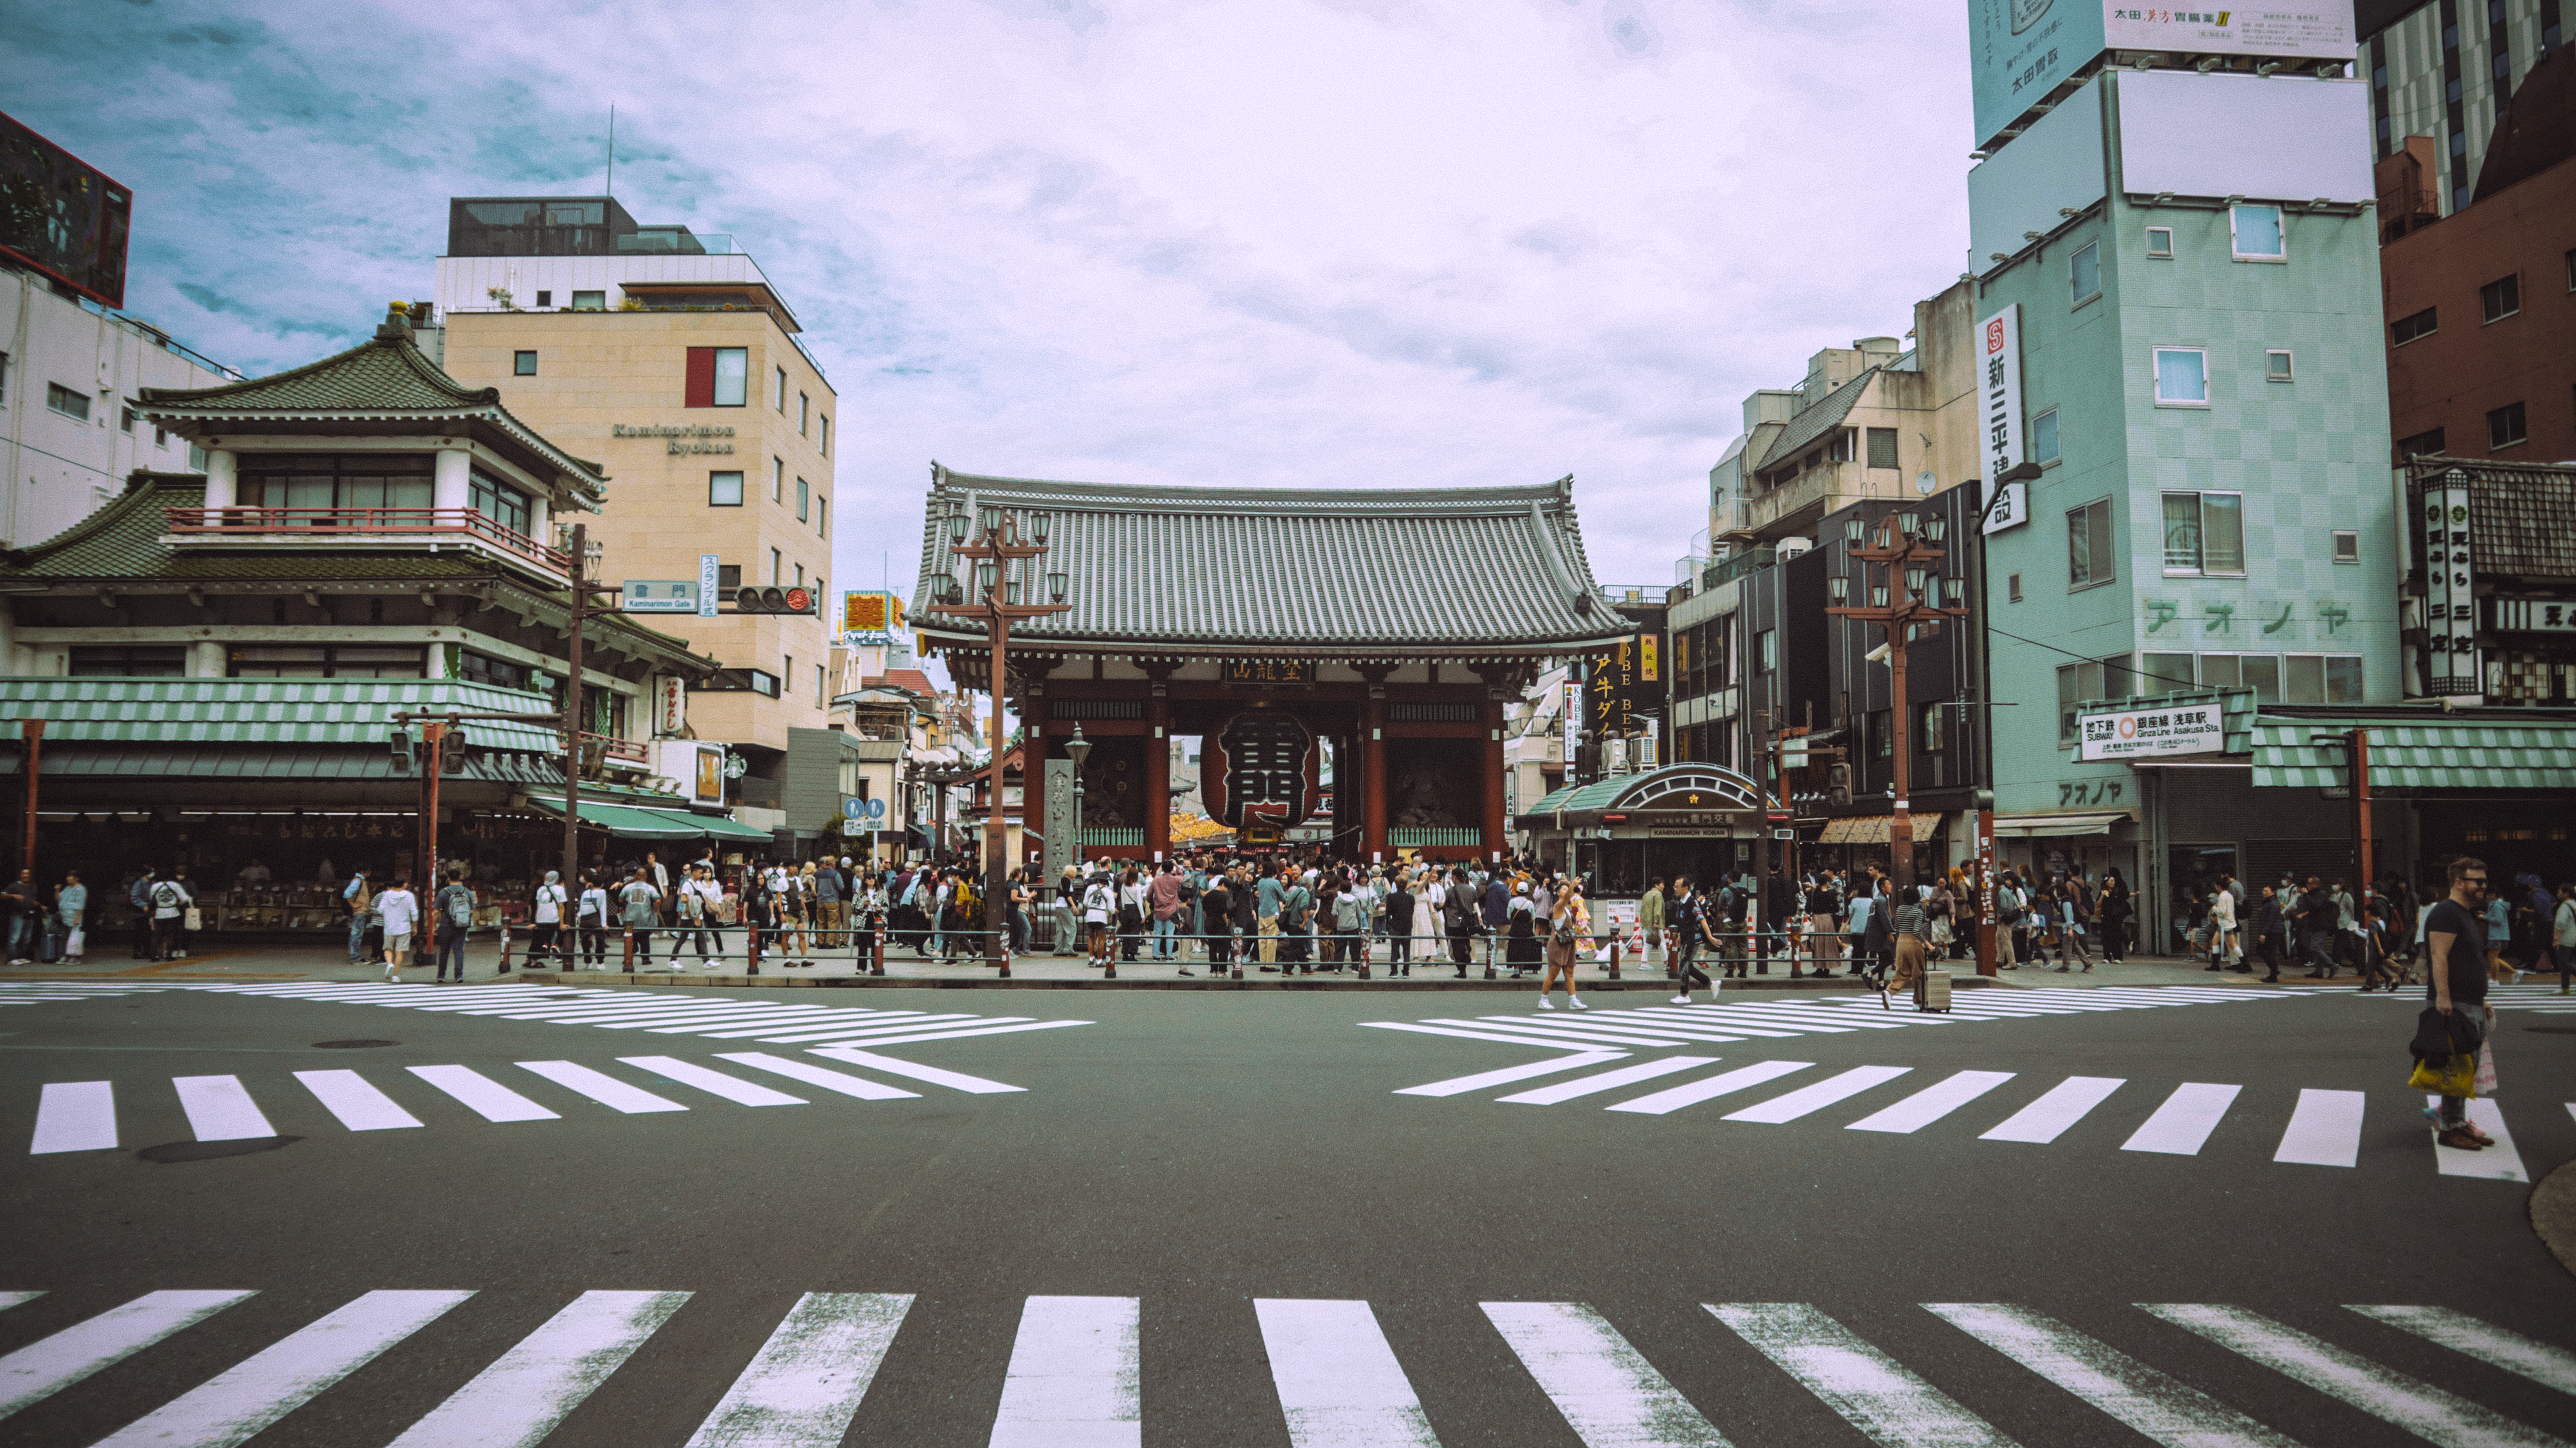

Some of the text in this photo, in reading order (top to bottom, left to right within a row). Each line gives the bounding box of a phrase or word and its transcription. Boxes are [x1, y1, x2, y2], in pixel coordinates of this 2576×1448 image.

[2012, 47, 2059, 96] 太田胃散
[614, 423, 735, 438] Kaminarimon
[667, 440, 735, 458] Ryokan
[847, 596, 884, 628] 薬
[2148, 602, 2349, 634] アオノヤ
[2087, 712, 2206, 733] 地下鉄 銀座線 浅草駅
[2087, 732, 2114, 741] SUBWAY
[2137, 729, 2156, 738] Ginza
[2174, 725, 2204, 735] Asakusa
[2206, 723, 2220, 732] Sta.
[2059, 781, 2121, 806] アオノヤ
